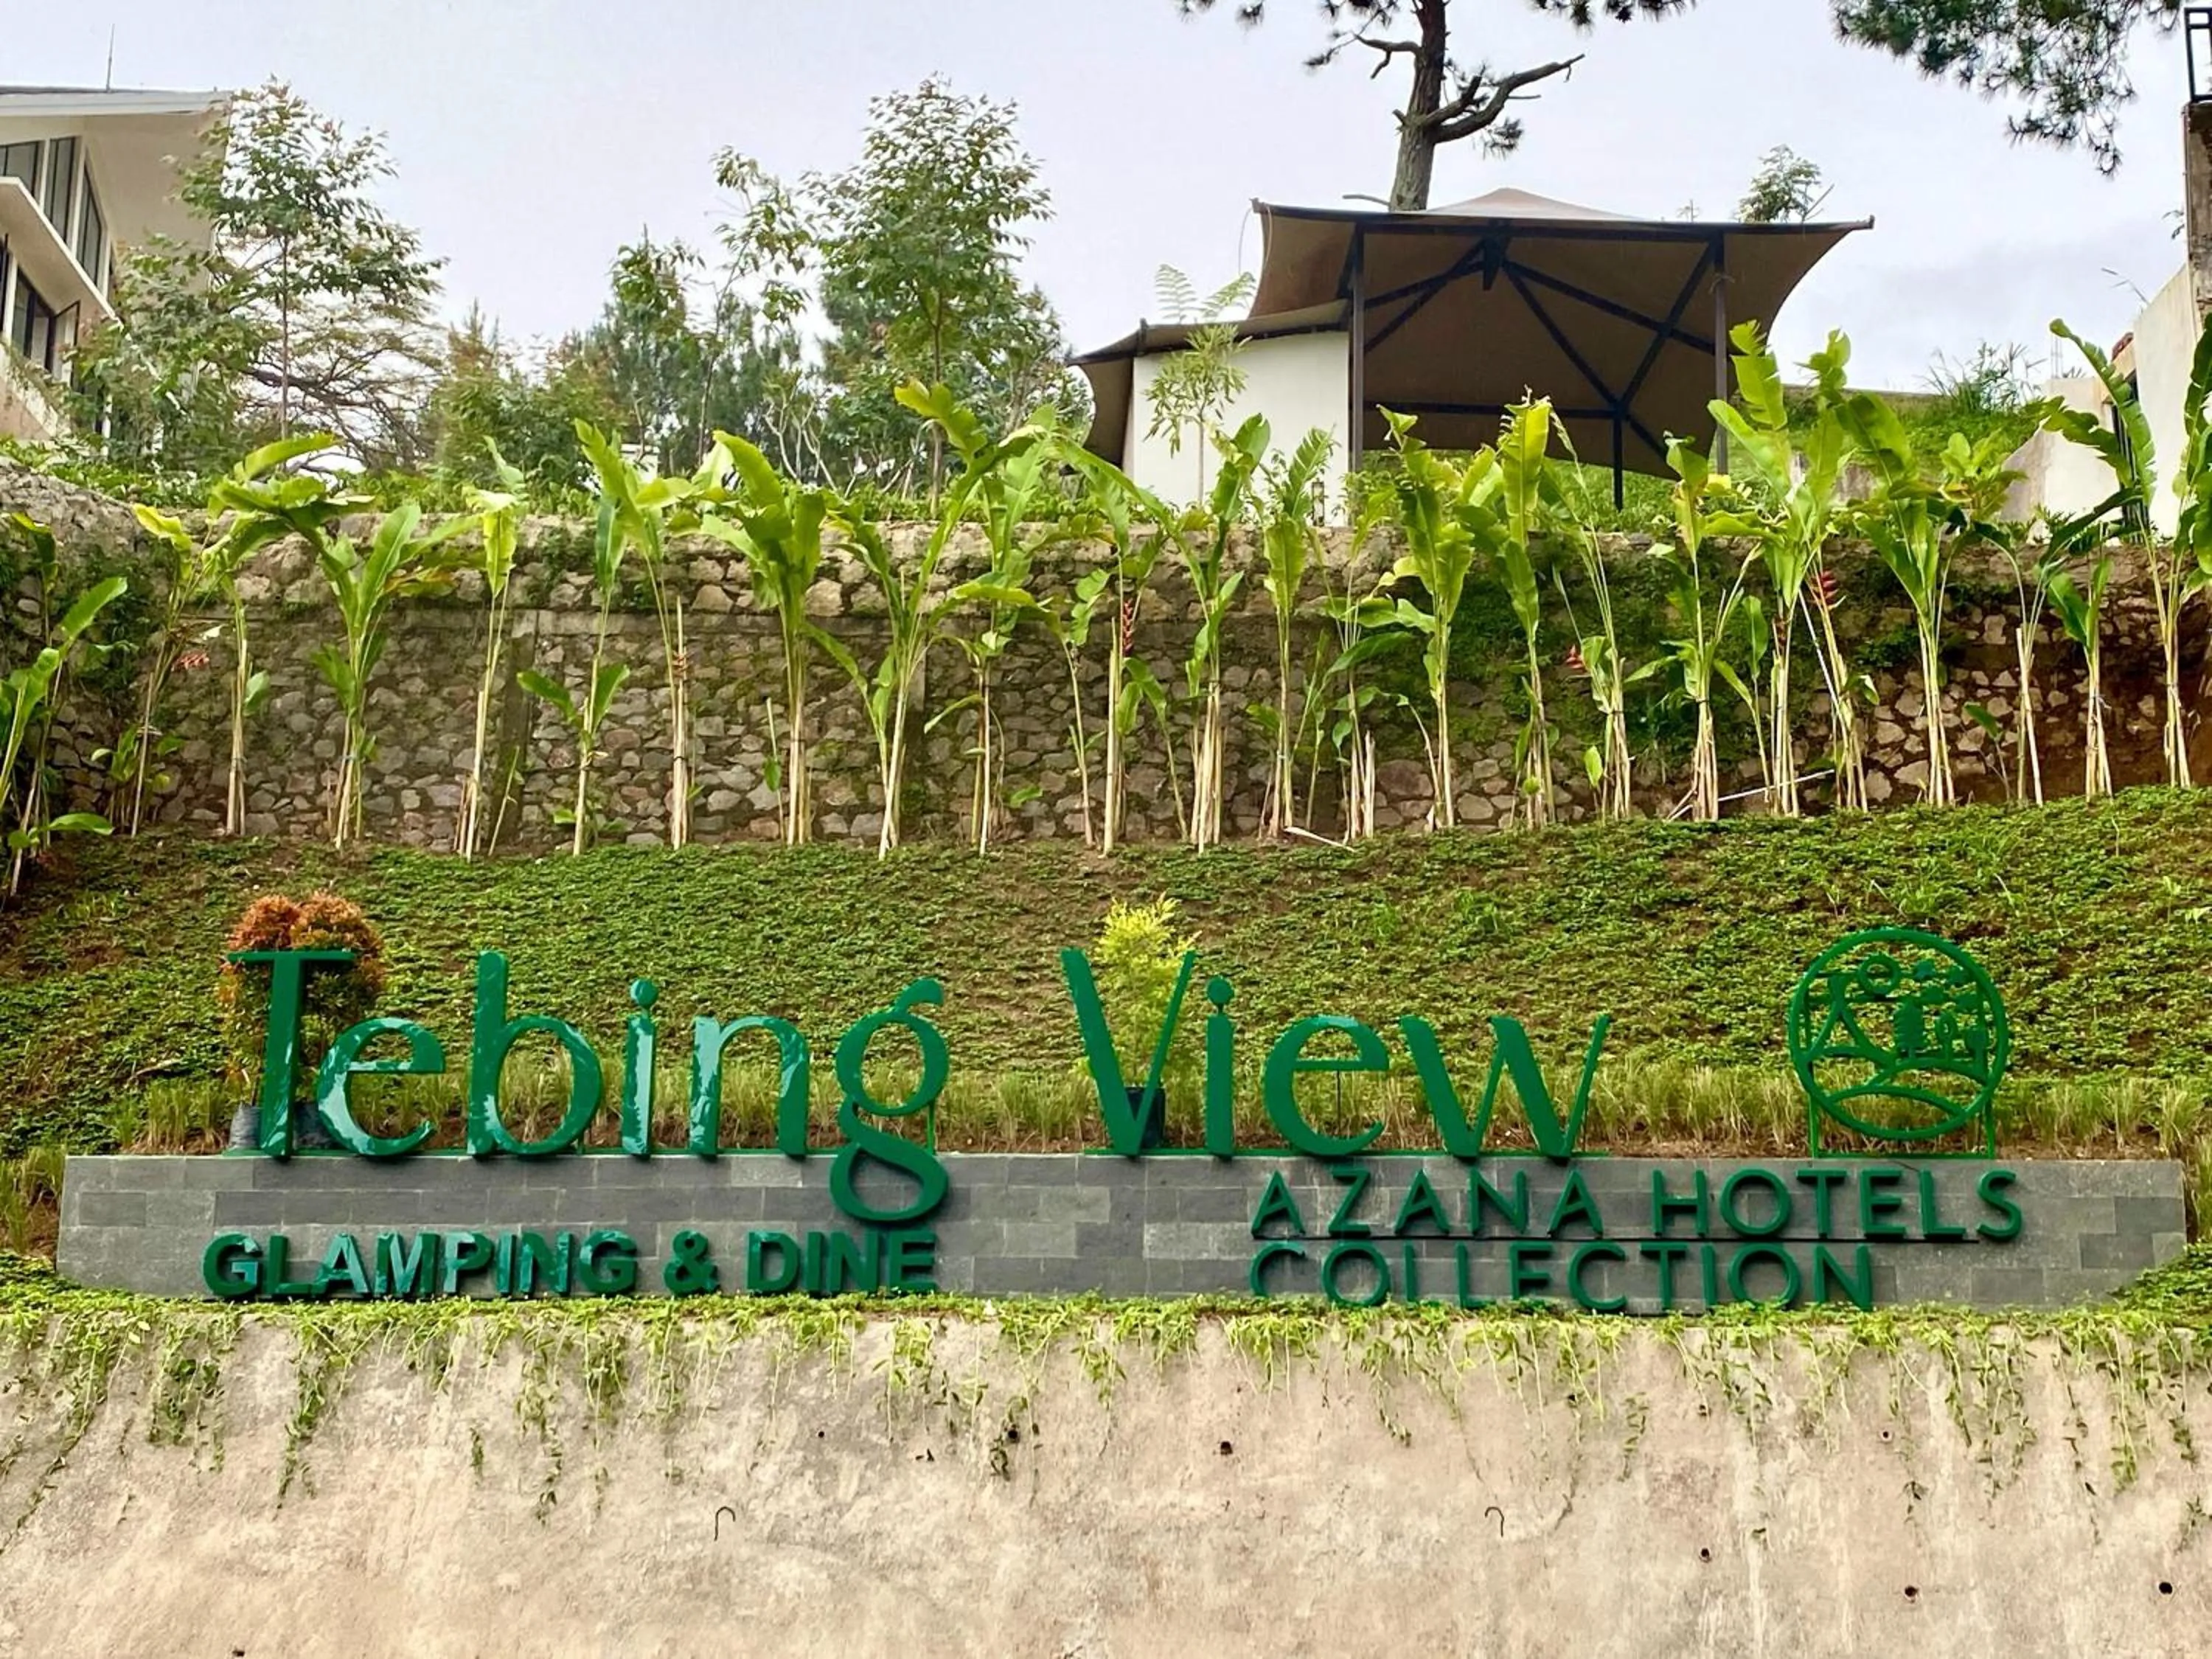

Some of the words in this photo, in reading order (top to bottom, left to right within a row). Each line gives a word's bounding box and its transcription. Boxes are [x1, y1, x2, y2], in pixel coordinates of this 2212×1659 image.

[228, 950, 950, 1222] Tebing
[1060, 948, 1610, 1158] View
[1251, 1169, 1603, 1237] AZANA
[1652, 1169, 2023, 1241] HOTELS
[202, 1231, 639, 1299] GLAMPING
[664, 1230, 719, 1295] &
[747, 1231, 937, 1295] DINE
[1250, 1241, 1874, 1311] COLLECTION
